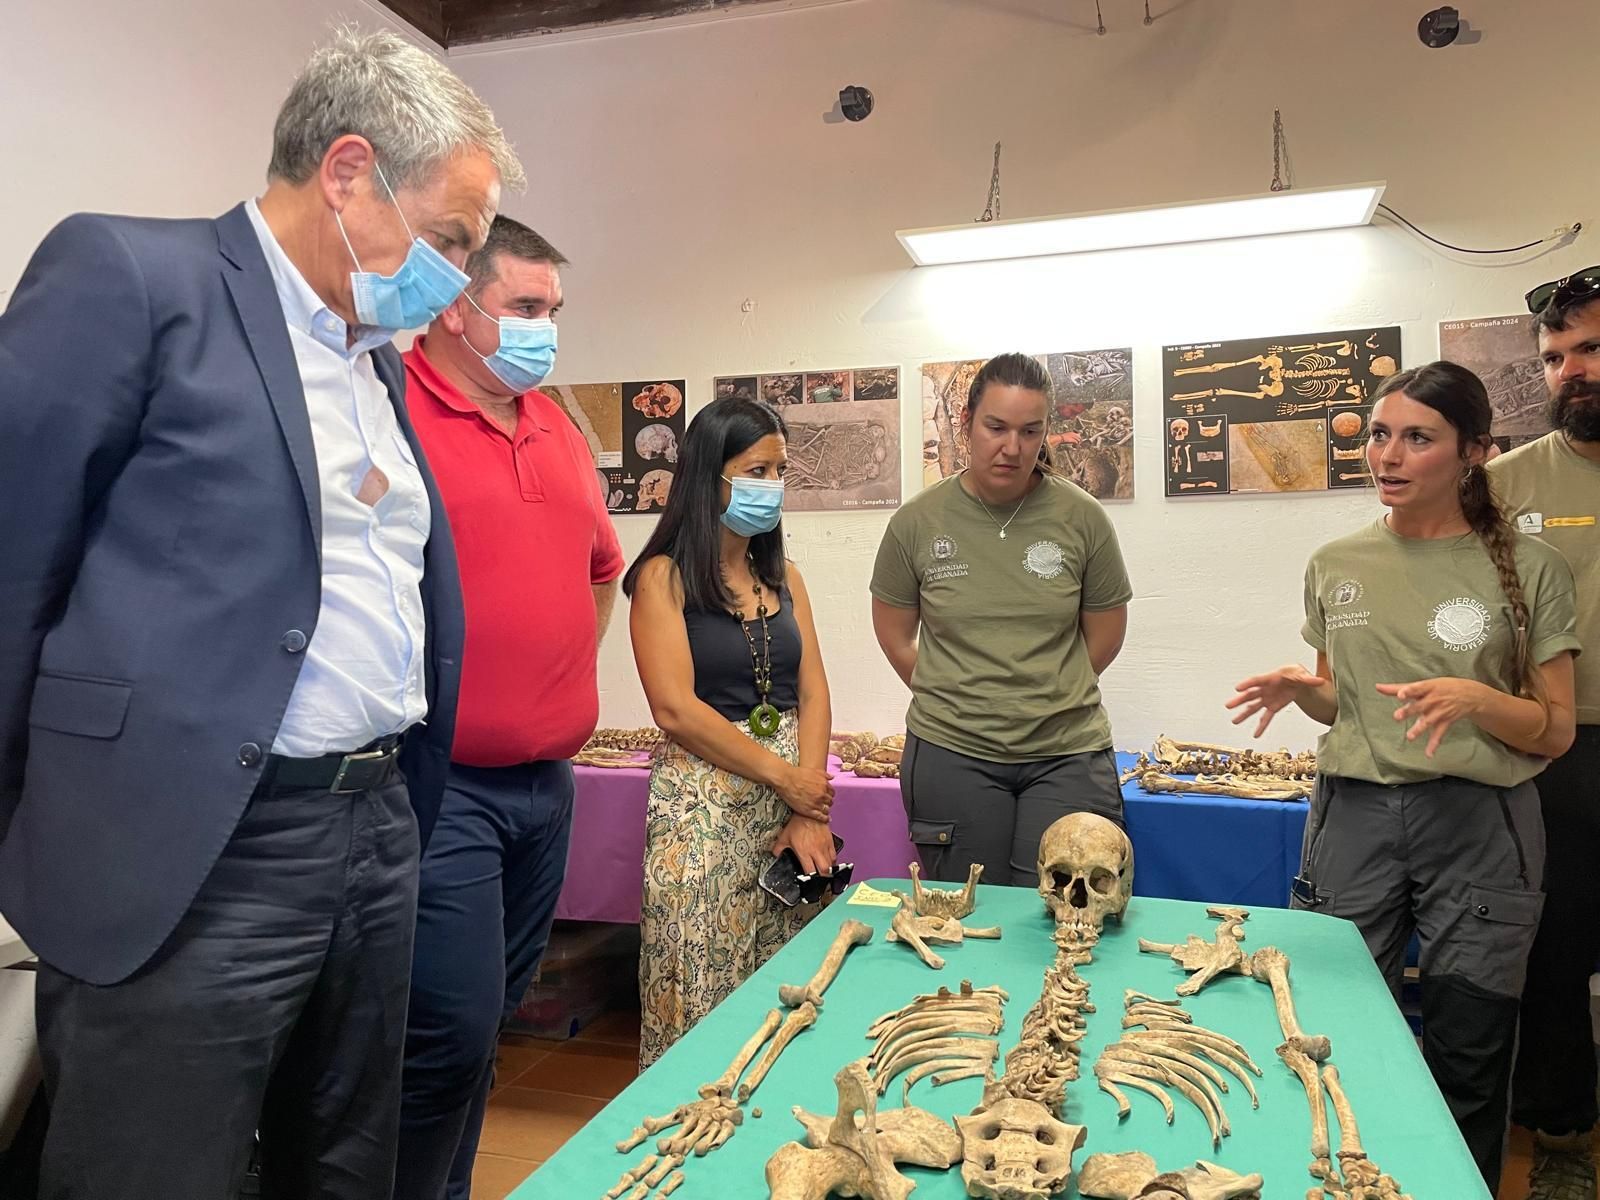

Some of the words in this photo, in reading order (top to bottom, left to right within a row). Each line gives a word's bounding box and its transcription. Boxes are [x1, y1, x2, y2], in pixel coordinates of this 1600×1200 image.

[1444, 322, 1464, 330] CE015
[1470, 319, 1501, 328] Campaña
[1502, 318, 1519, 326] 2024
[933, 569, 969, 580] GRANADA
[1432, 597, 1491, 622] UNIVERSIDAD
[1426, 620, 1439, 640] UGR
[1443, 631, 1489, 652] MEMORIA
